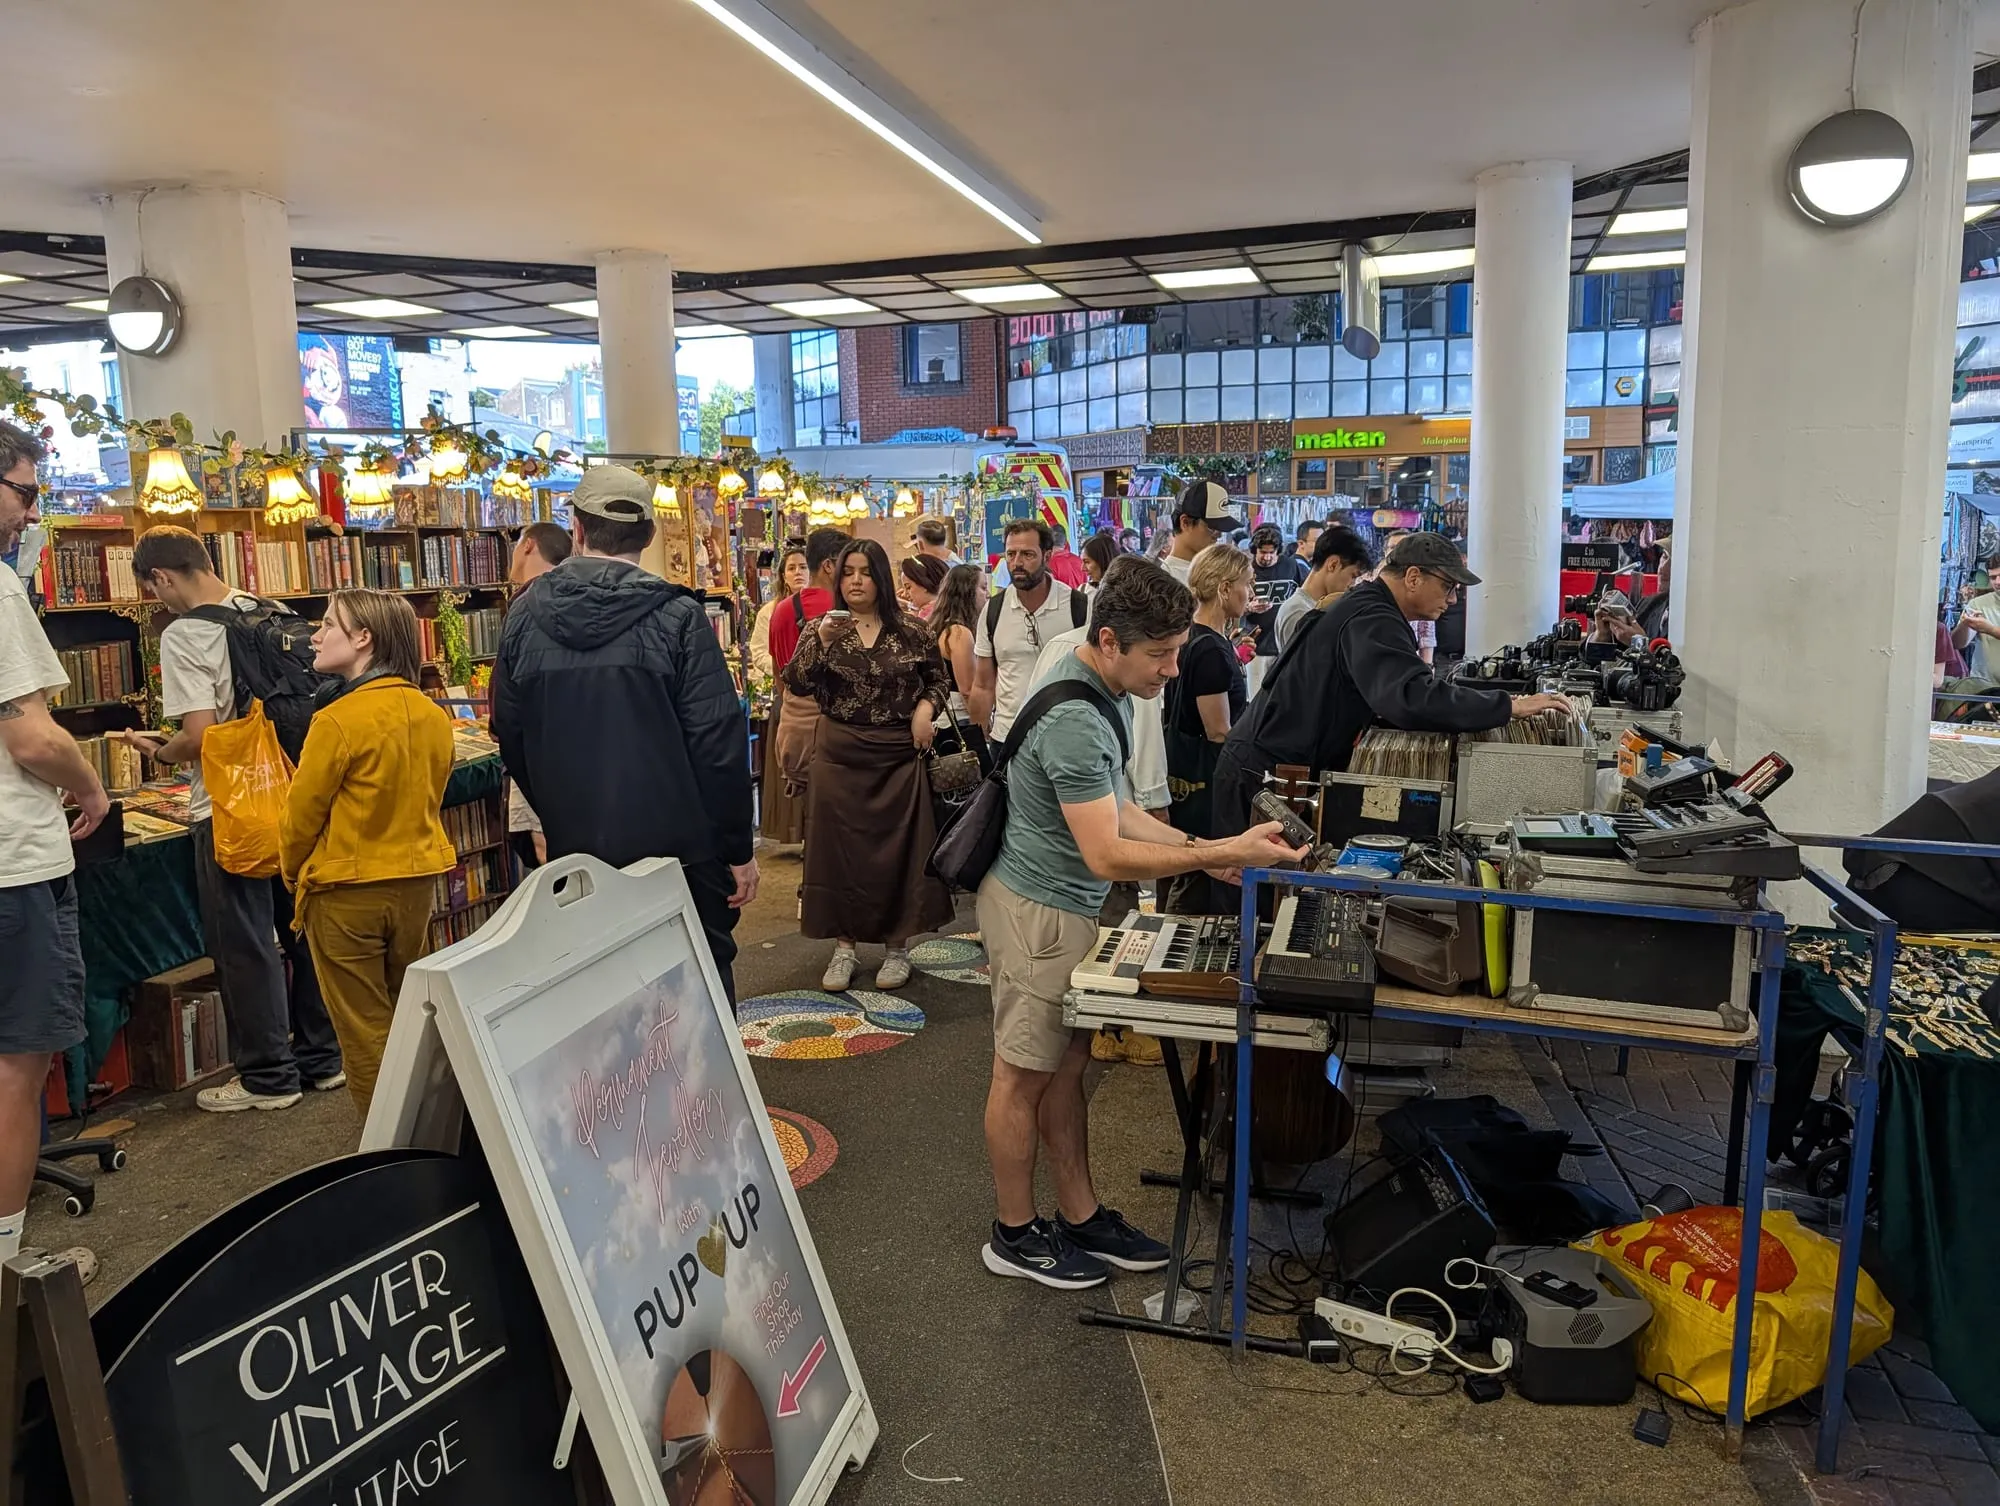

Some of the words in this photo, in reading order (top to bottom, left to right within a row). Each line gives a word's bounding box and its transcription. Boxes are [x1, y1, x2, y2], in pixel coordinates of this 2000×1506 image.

[347, 340, 364, 351] GOT
[348, 349, 382, 364] MOVES?
[1295, 428, 1386, 449] makan
[1567, 556, 1581, 566] FREE
[1581, 556, 1611, 567] ENGRAVING
[1584, 546, 1595, 556] £10
[571, 1001, 683, 1159] Permanent
[634, 1081, 729, 1225] Jewellery
[633, 1252, 700, 1360] PUP
[721, 1183, 761, 1249] UP
[752, 1290, 775, 1321] Find
[773, 1271, 790, 1298] Our
[238, 1250, 451, 1401] OLIVER
[765, 1330, 786, 1359] This
[783, 1305, 803, 1335] Way
[228, 1302, 481, 1493] VINTAGE
